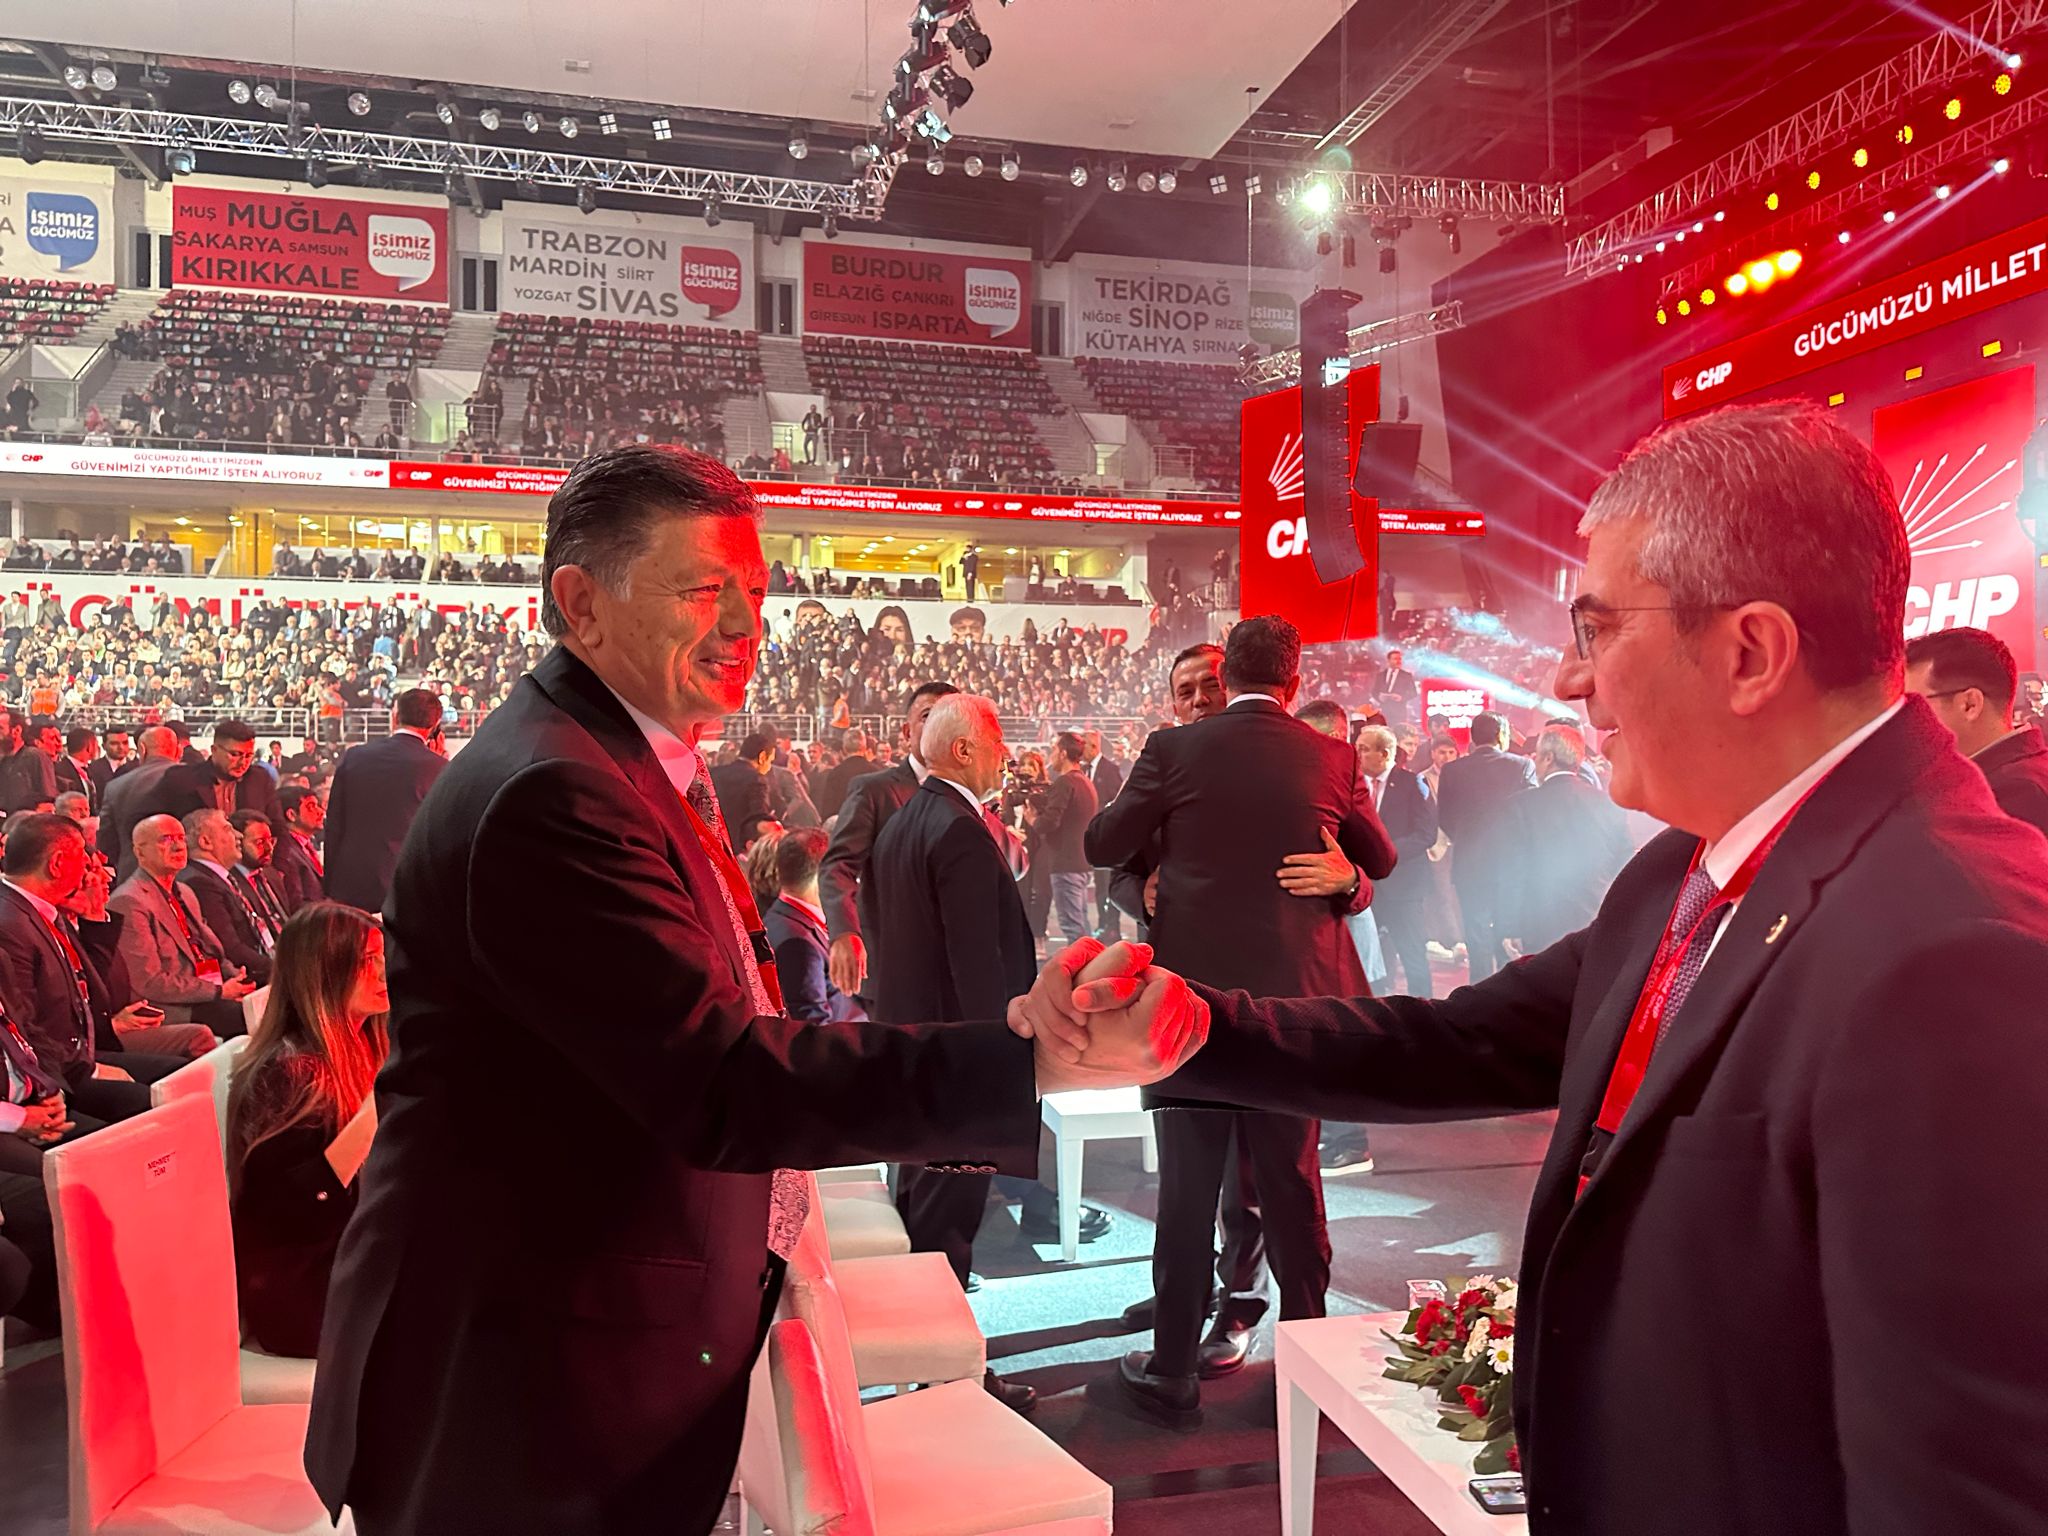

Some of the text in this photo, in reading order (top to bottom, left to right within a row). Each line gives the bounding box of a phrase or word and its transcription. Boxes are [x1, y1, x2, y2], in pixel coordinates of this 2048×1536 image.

[180, 202, 358, 236] MUŞ MUĞLA
[30, 226, 95, 240] GÜCÜMÜZ
[174, 231, 349, 257] SAKARYA SAMSUN
[522, 228, 667, 261] TRABZON
[373, 248, 430, 261] GÜCÜMÜZ
[182, 257, 360, 290] KIRIKKALE
[509, 255, 606, 280] MARDİN
[831, 254, 944, 284] BURDUR
[514, 281, 679, 318] YOZGAT SİVAS
[812, 283, 954, 307] ELAZIĞ ÇANKIRI
[1094, 276, 1231, 307] TEKİRDAĞ
[809, 309, 969, 335] GİRESUN ISPARTA
[1082, 304, 1244, 331] NİĞDE SİNOP RİZE
[1696, 242, 2047, 391] CHP GÜCÜMÜZÜ MİLLET
[1085, 329, 1244, 354] KÜTAHYA ŞIRNA
[21, 454, 43, 462] CHP
[134, 453, 263, 466] GÜCÜMÜZÜ MİLLETİMİZDEN
[71, 461, 322, 481] GÜVENİMİZİ YAPTIĞIMIZ İŞTEN ALIYORUZ
[410, 471, 432, 481] CHP
[443, 477, 507, 490] GÜVENİMİZİ
[895, 502, 942, 512] ALIYORUZ
[1652, 995, 1664, 1018] CHP
